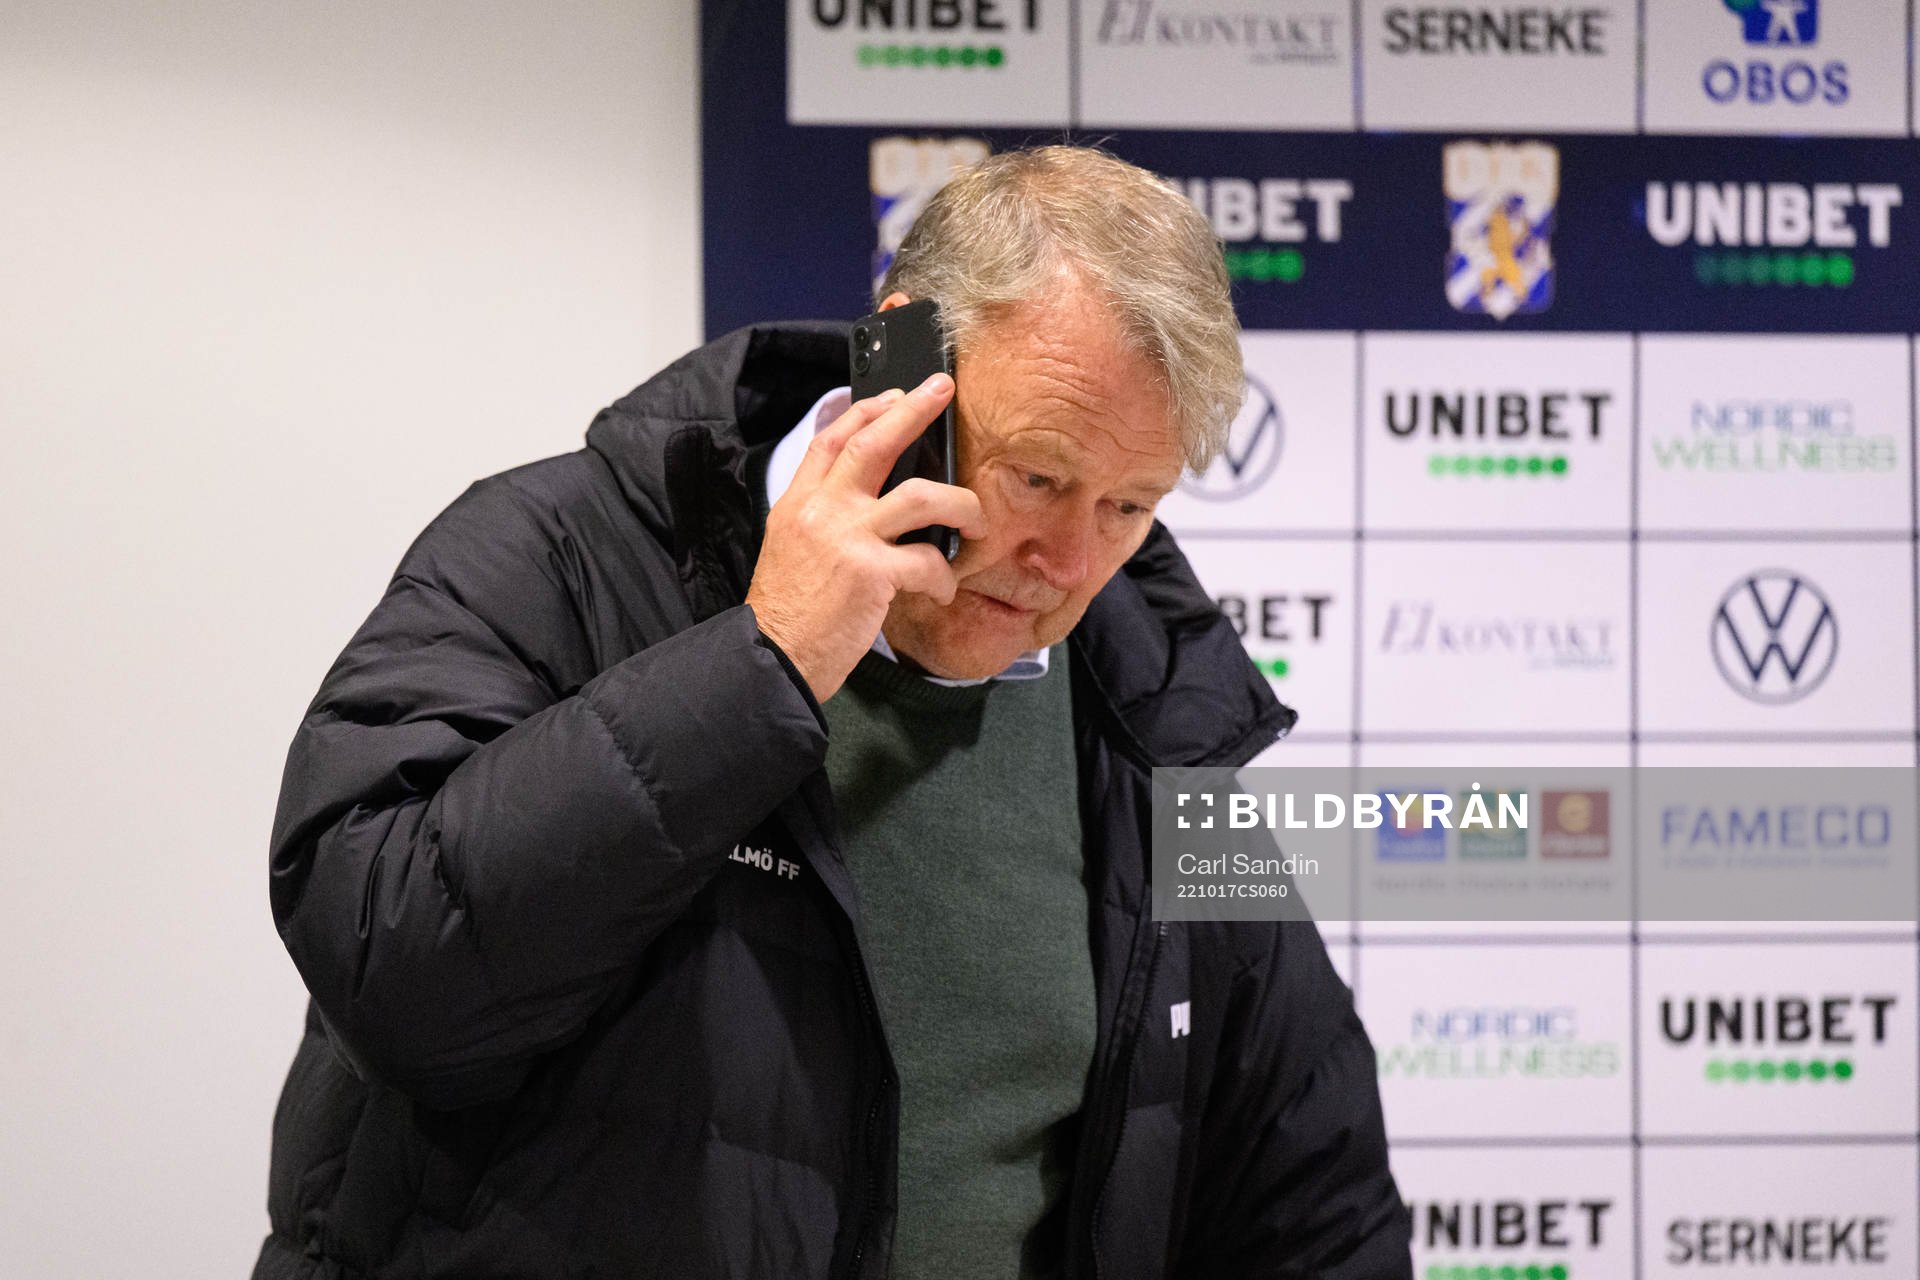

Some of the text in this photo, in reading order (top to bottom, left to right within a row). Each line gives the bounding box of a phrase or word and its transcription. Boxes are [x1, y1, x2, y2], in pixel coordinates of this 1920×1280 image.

[812, 0, 1040, 32] UNIBET
[1383, 8, 1607, 56] SERNEKE
[1702, 59, 1851, 104] OBOS
[1645, 181, 1902, 247] UNIBET
[1384, 391, 1613, 441] UNIBET
[1690, 398, 1854, 436] NORDIC
[1650, 436, 1899, 473] WELLNESS
[1660, 804, 1892, 849] FAMECO
[728, 843, 800, 880] LMÖ FF
[1658, 998, 1898, 1046] UNIBET
[1377, 1043, 1620, 1079] WELLNESS
[1407, 1201, 1614, 1249] NIBET
[1666, 1215, 1891, 1265] SERNEKE
